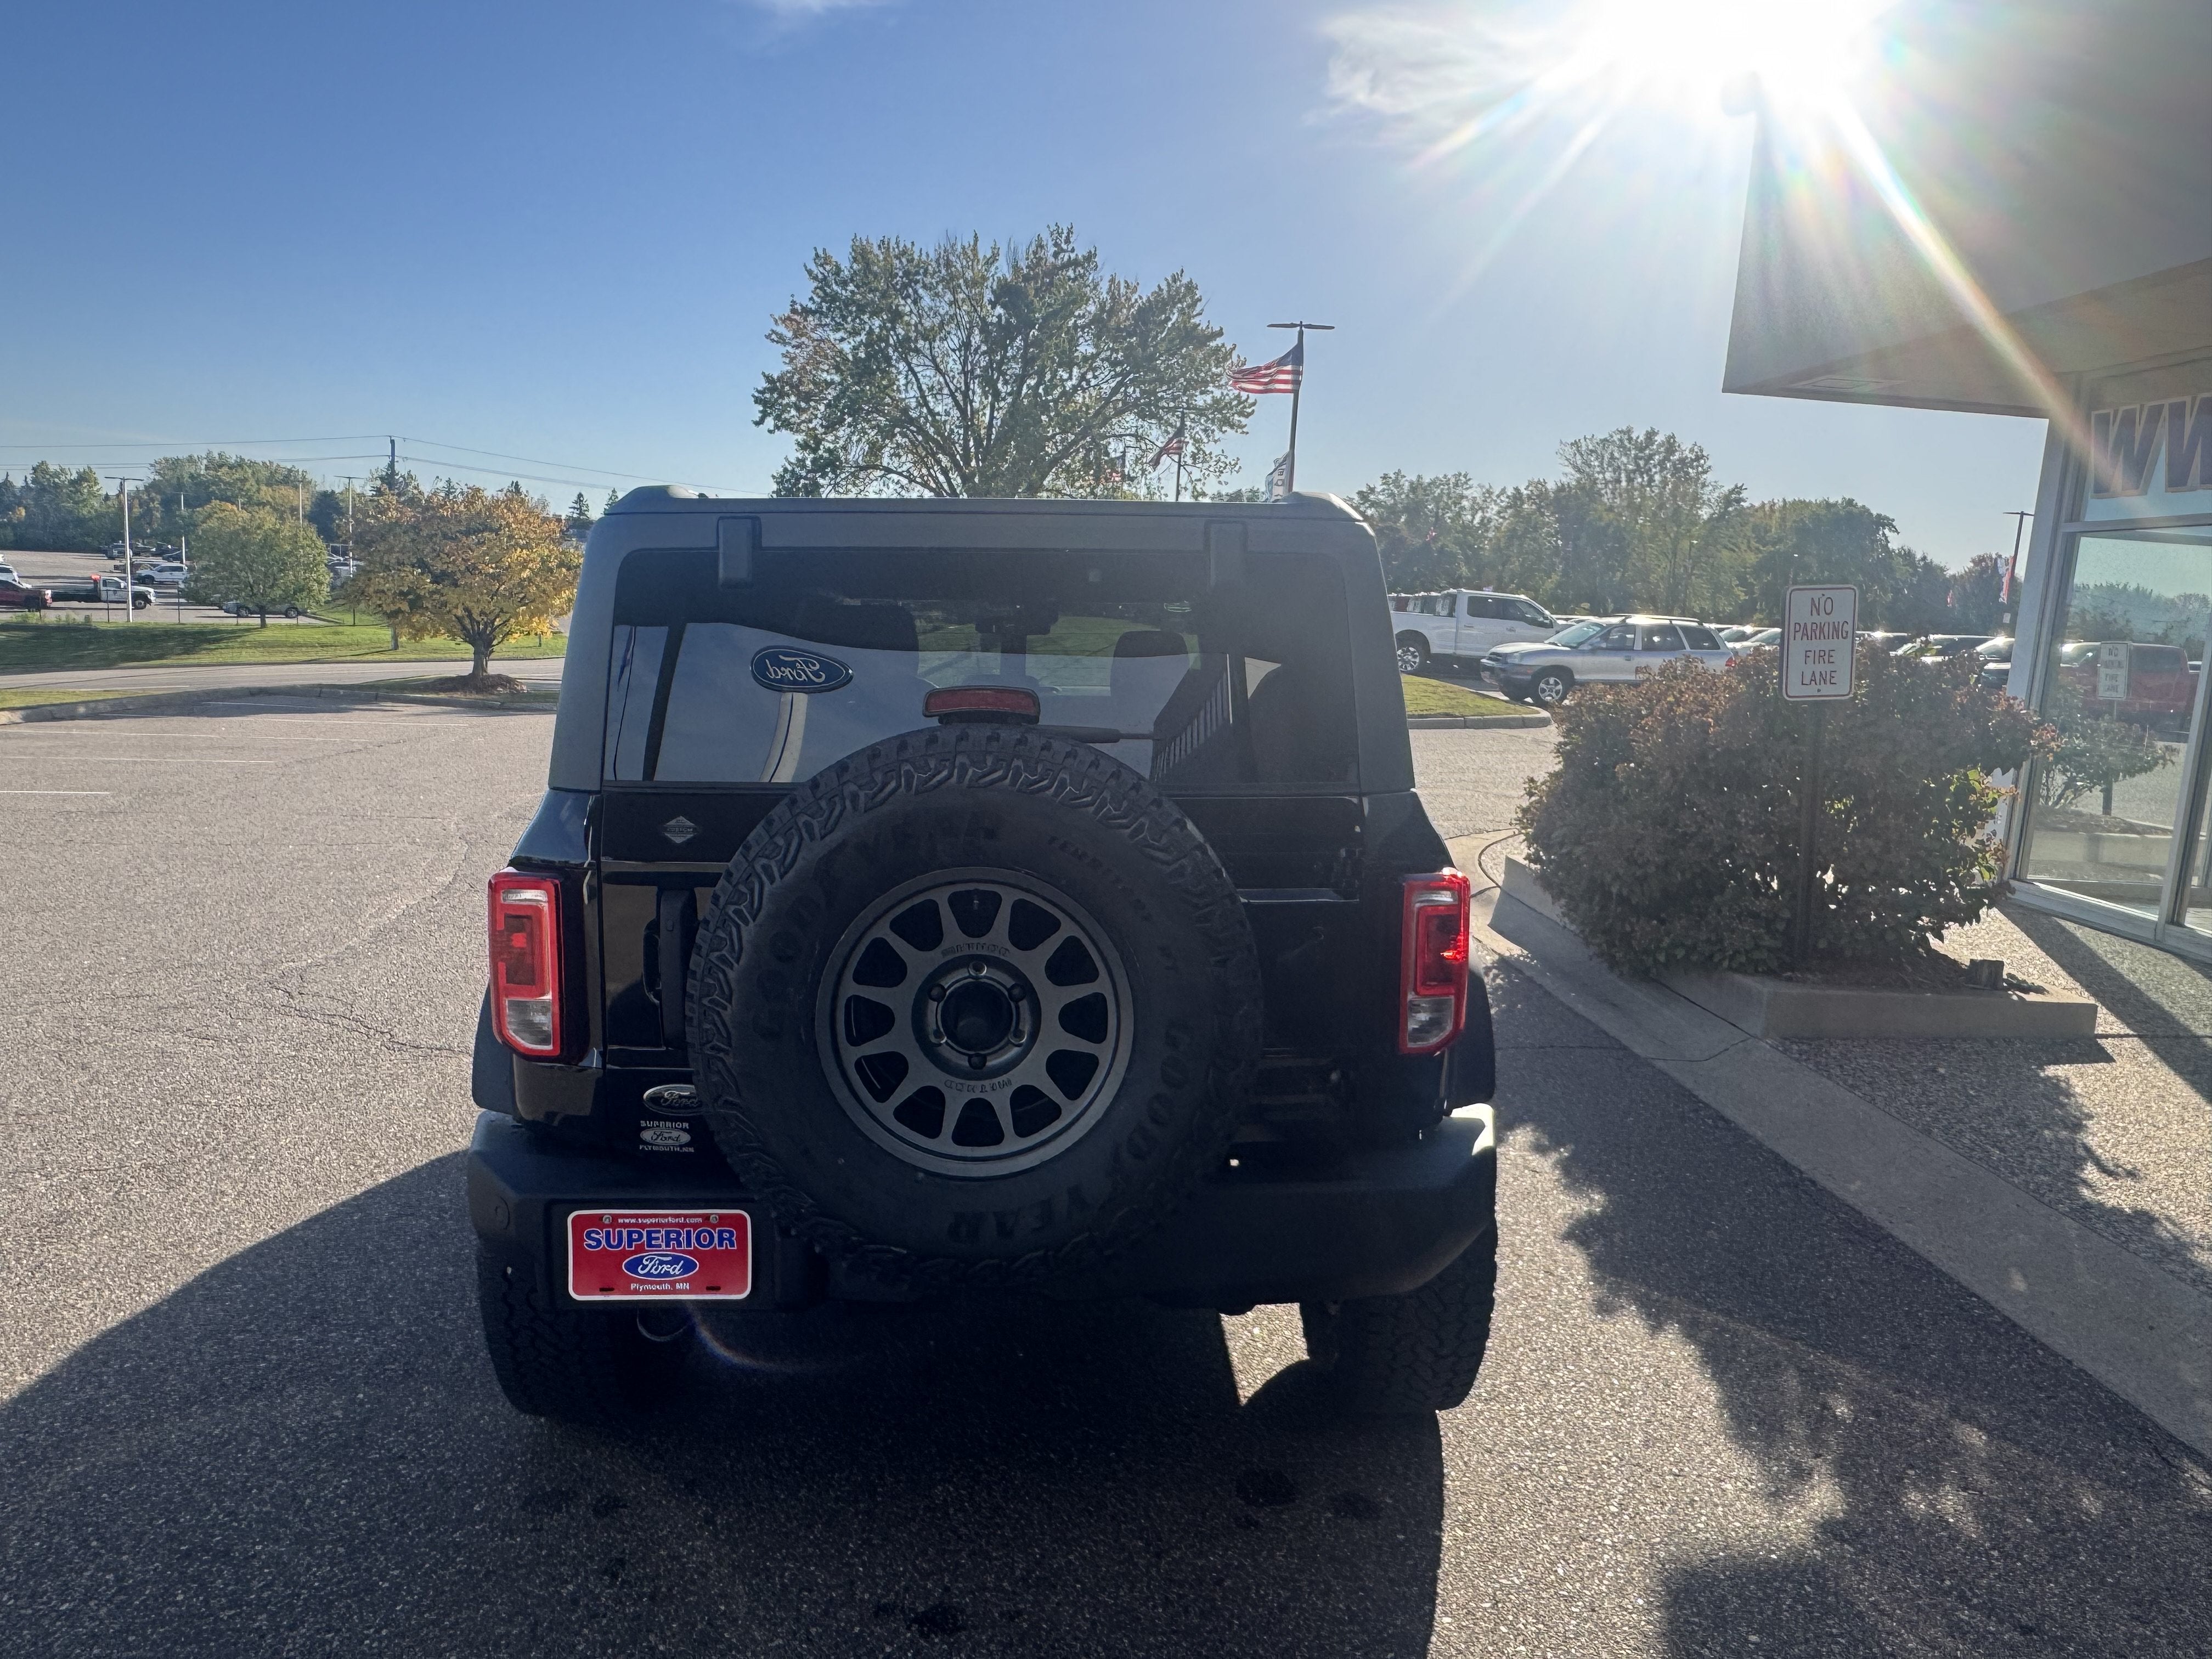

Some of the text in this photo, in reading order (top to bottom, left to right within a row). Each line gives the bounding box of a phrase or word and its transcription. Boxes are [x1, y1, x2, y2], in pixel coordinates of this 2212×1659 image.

[1810, 596, 1834, 616] NO
[1793, 620, 1849, 641] PARKING
[1804, 650, 1836, 664] FIRE
[1801, 670, 1837, 686] LANE
[661, 1090, 699, 1108] Ford
[651, 1131, 681, 1142] Ford
[618, 1216, 703, 1224] www.superiorford.com
[583, 1227, 737, 1251] SUPERIOR
[637, 1257, 684, 1276] Ford
